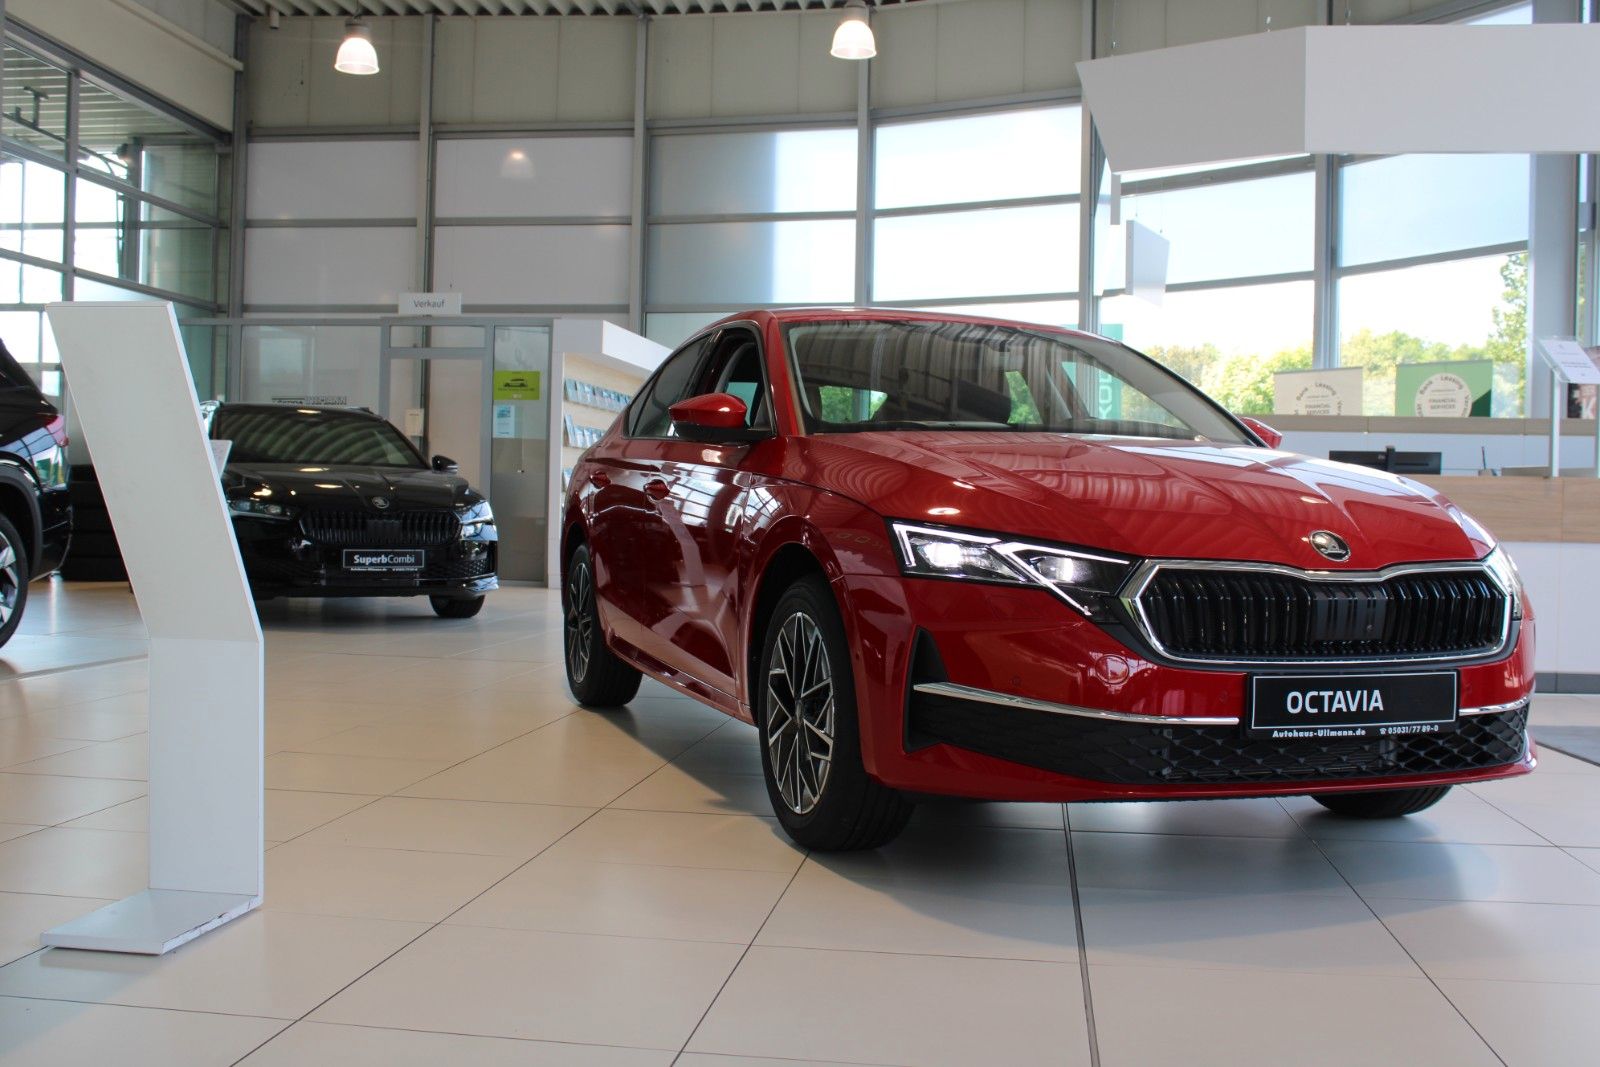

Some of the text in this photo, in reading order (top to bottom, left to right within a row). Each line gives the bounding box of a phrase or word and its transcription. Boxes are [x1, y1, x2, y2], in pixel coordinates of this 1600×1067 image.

[413, 299, 445, 308] Verkauf
[353, 554, 415, 566] SuperbCombi
[1286, 689, 1384, 714] OCTAVIA
[1272, 728, 1366, 738] Autohaus-Ullmann.de
